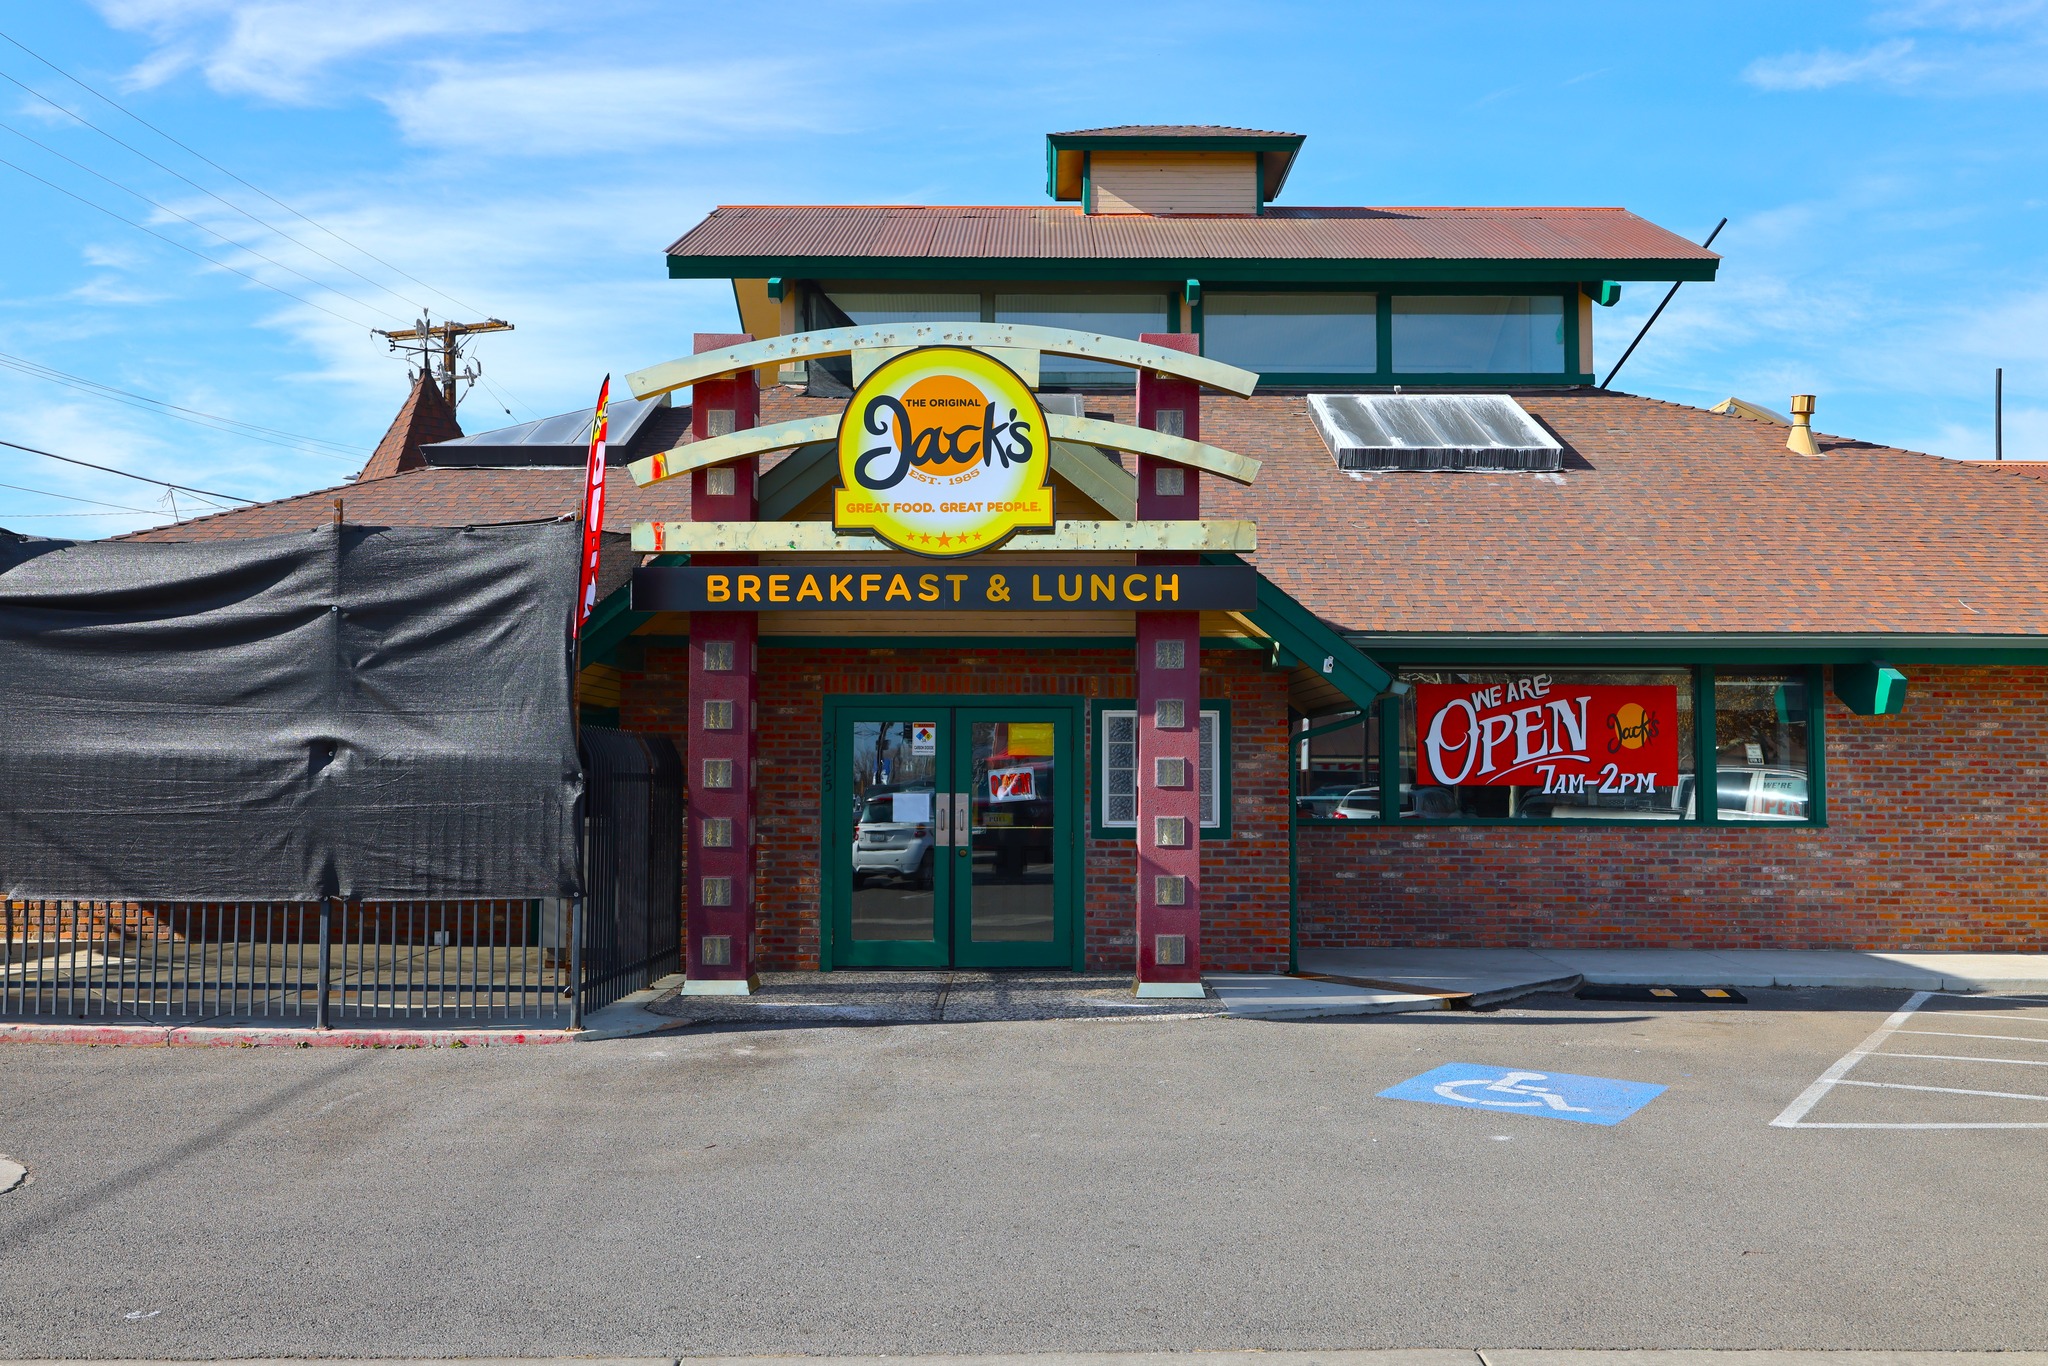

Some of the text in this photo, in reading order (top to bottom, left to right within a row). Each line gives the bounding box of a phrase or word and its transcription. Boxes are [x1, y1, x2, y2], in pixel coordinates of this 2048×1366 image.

[906, 398, 981, 407] THE ORIGINAL
[854, 394, 1033, 490] Jack's
[907, 468, 981, 485] EST. 1985
[846, 501, 1042, 514] GREAT FOOD. GREAT PEOPLE.
[707, 573, 1180, 602] BREAKFAST & LUNCH
[1471, 673, 1553, 712] WE ARE
[1423, 696, 1592, 786] OPEN
[1606, 709, 1660, 754] Jack's
[823, 731, 833, 792] 2325
